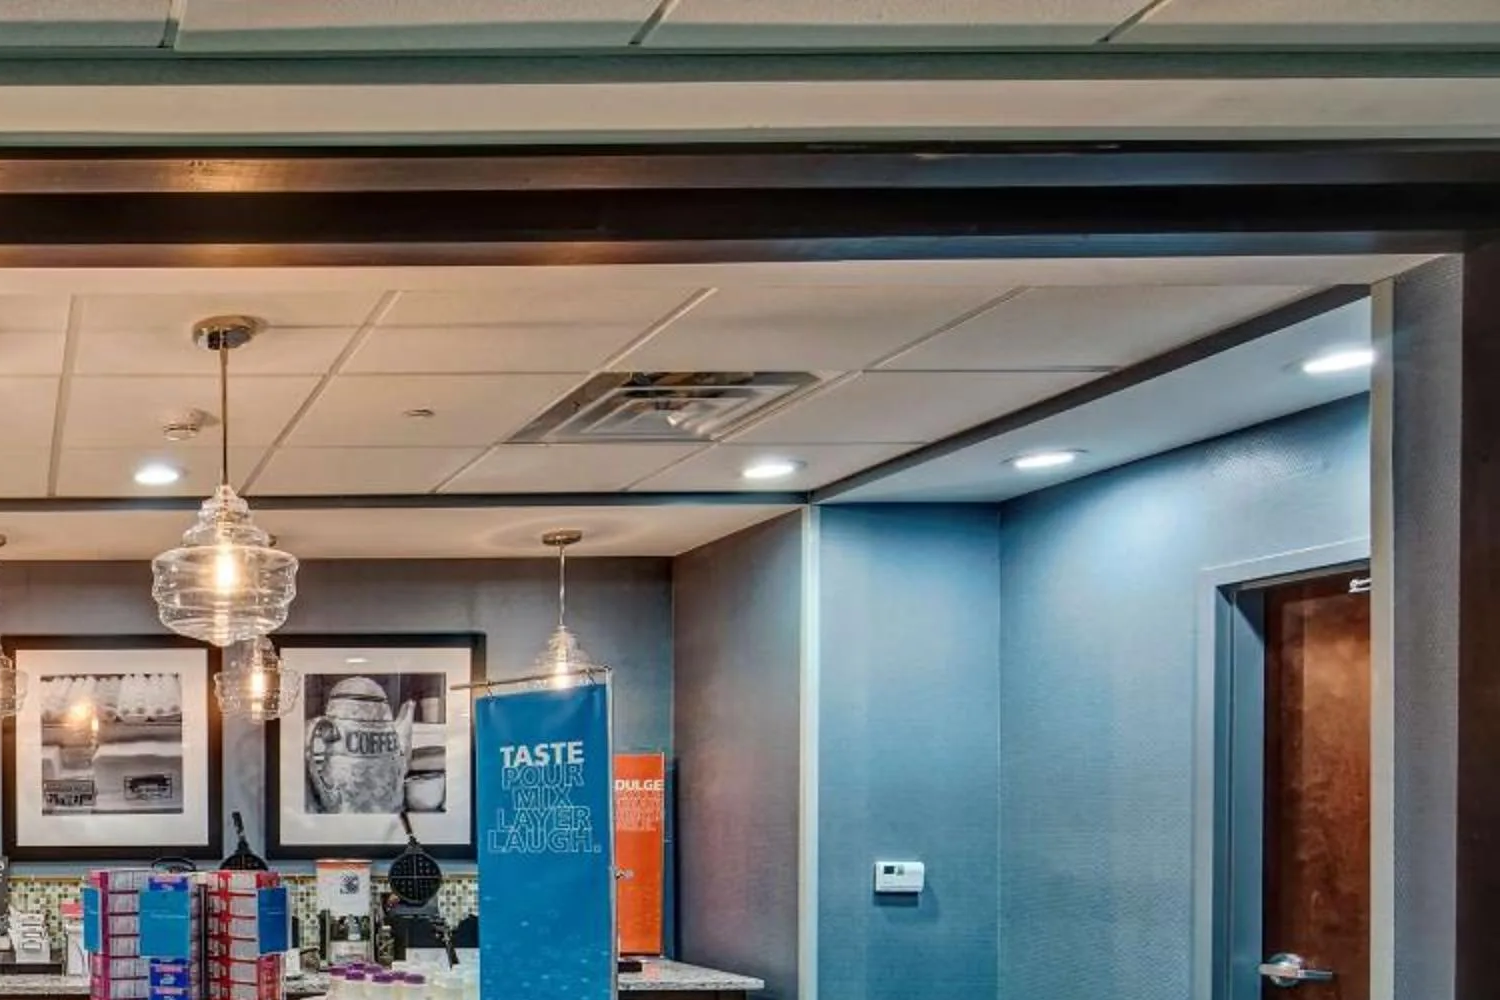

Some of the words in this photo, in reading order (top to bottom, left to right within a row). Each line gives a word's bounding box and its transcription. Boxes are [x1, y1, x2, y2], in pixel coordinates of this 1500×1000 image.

[500, 741, 584, 769] TASTE
[501, 764, 585, 791] POUR
[615, 779, 664, 791] DULGE
[512, 785, 573, 811] MIX
[496, 805, 592, 832] LAYER
[487, 828, 602, 853] LAUGH.
